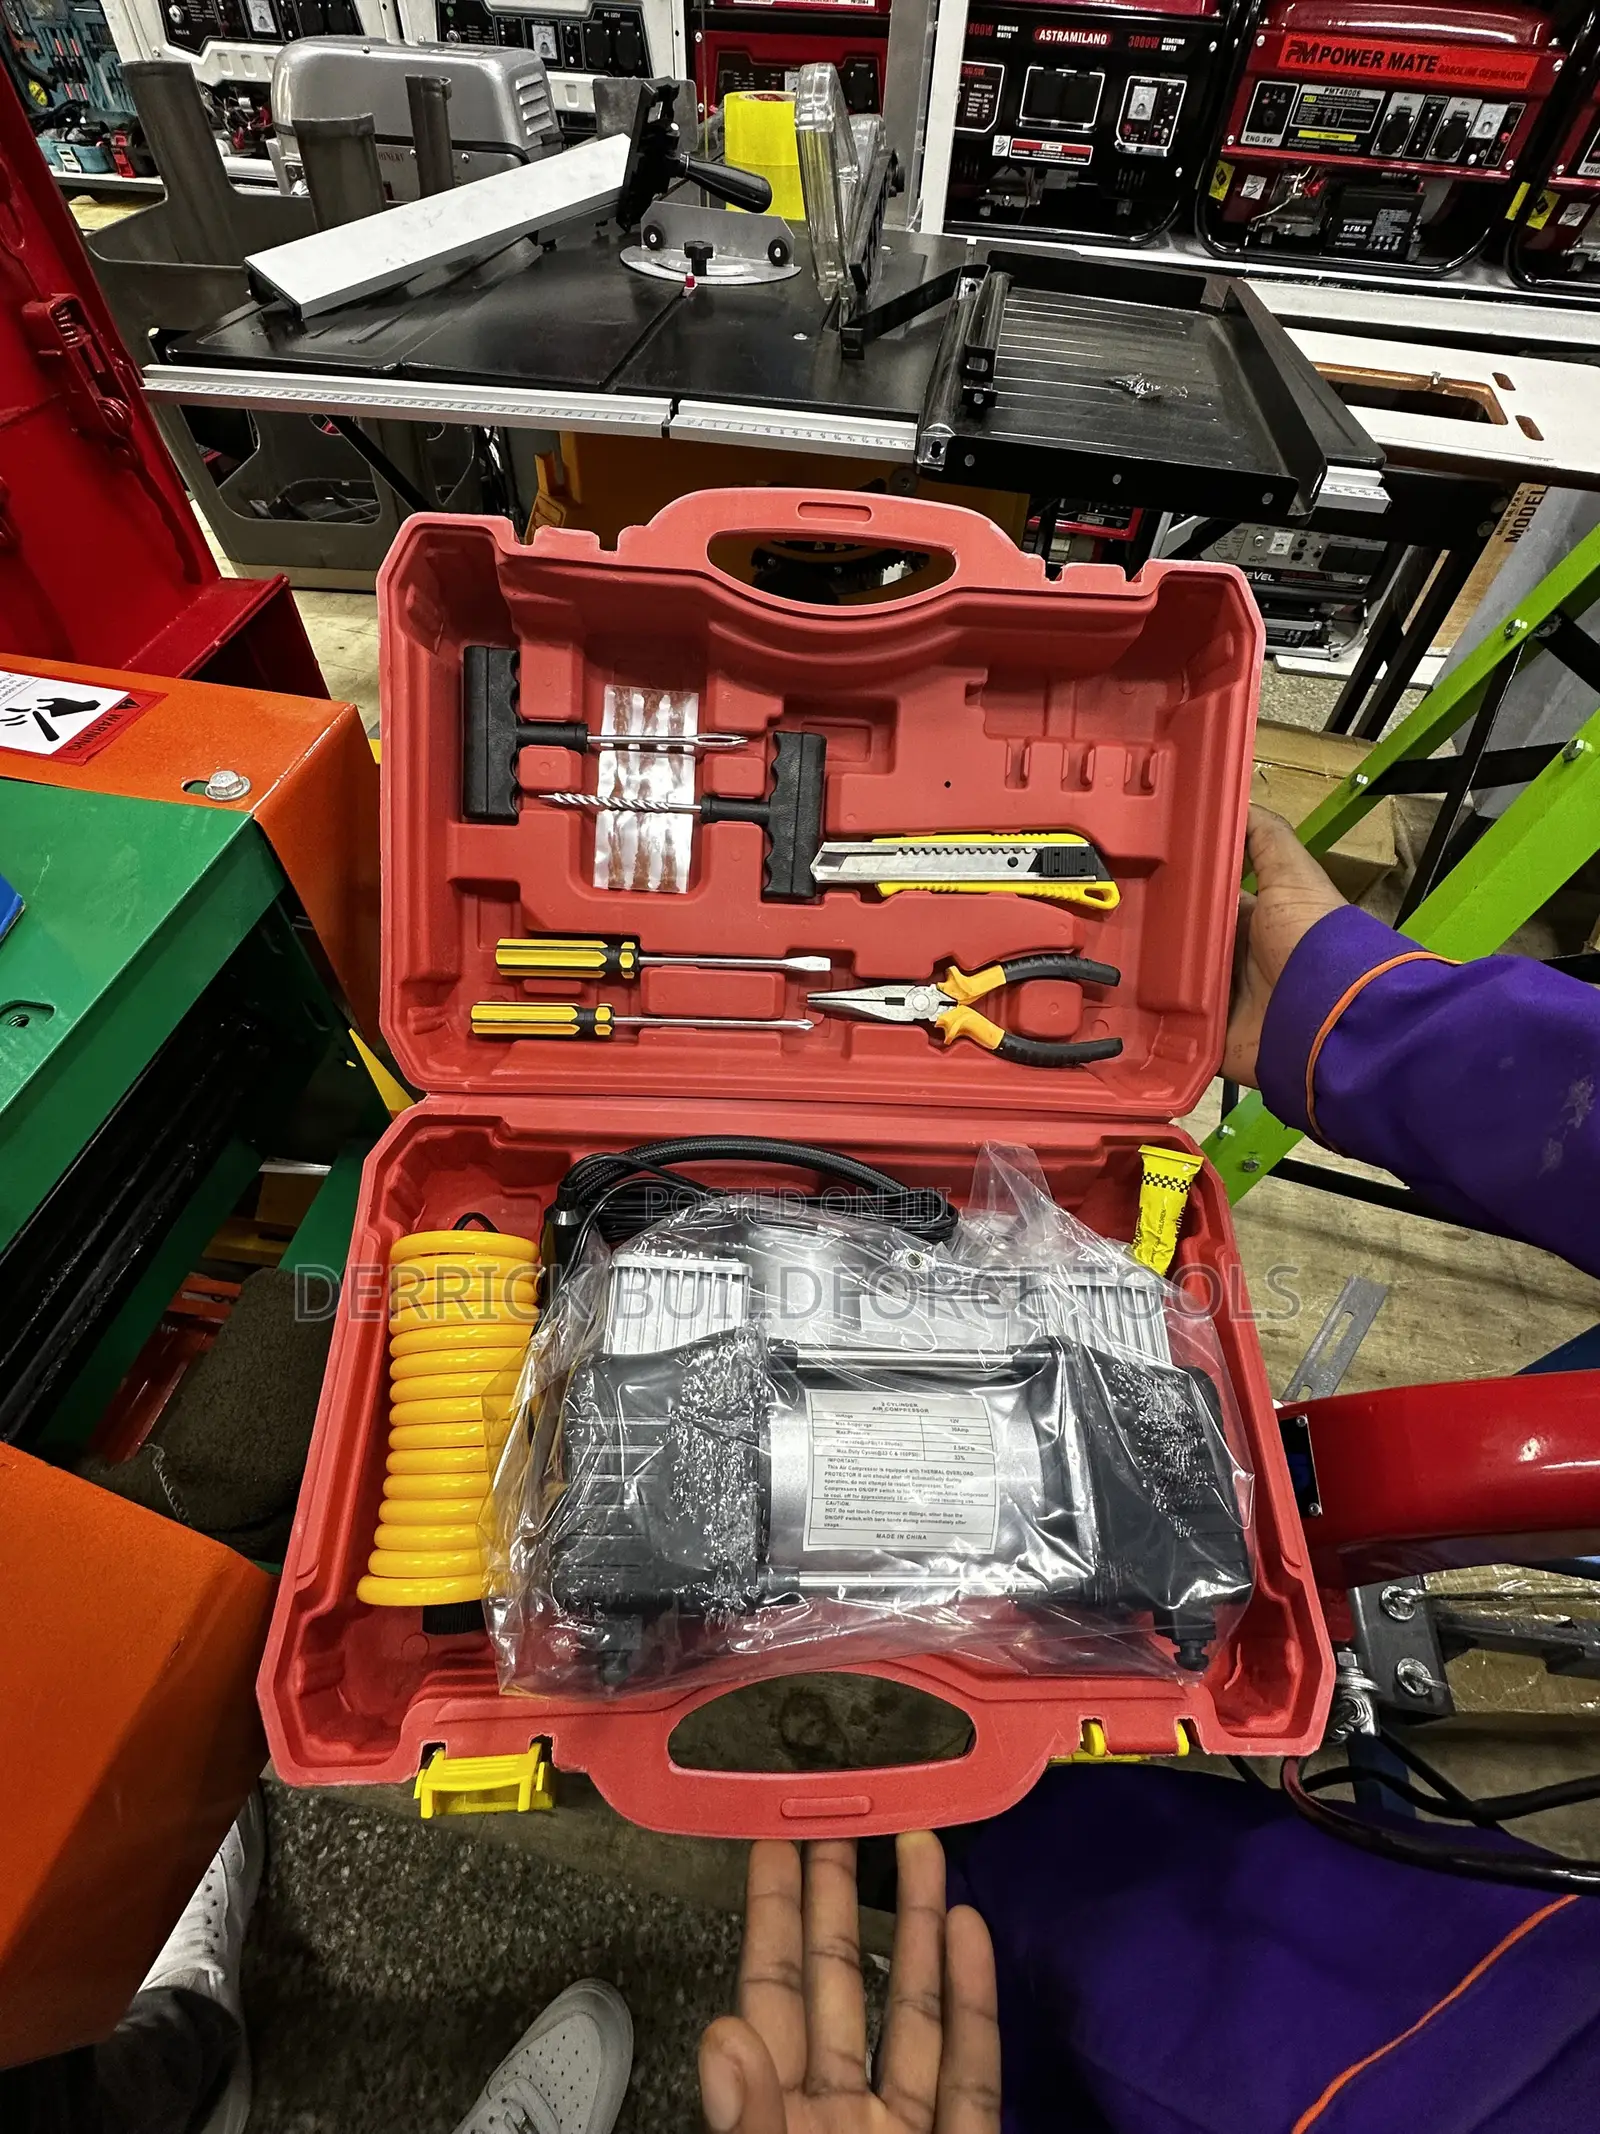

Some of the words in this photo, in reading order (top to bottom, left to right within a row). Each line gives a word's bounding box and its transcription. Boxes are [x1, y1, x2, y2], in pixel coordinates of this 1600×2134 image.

[966, 23, 994, 36] 800W
[1039, 29, 1107, 45] ASTRAMILANO
[1128, 35, 1160, 49] 3000W
[1319, 46, 1386, 69] POWER
[1387, 51, 1440, 74] MATE
[1503, 485, 1549, 543] MODEL
[66, 714, 125, 751] WARNING
[1157, 1209, 1167, 1235] CHILDREN
[884, 1406, 930, 1414] COMPRESSOR
[848, 1465, 878, 1473] Compressor
